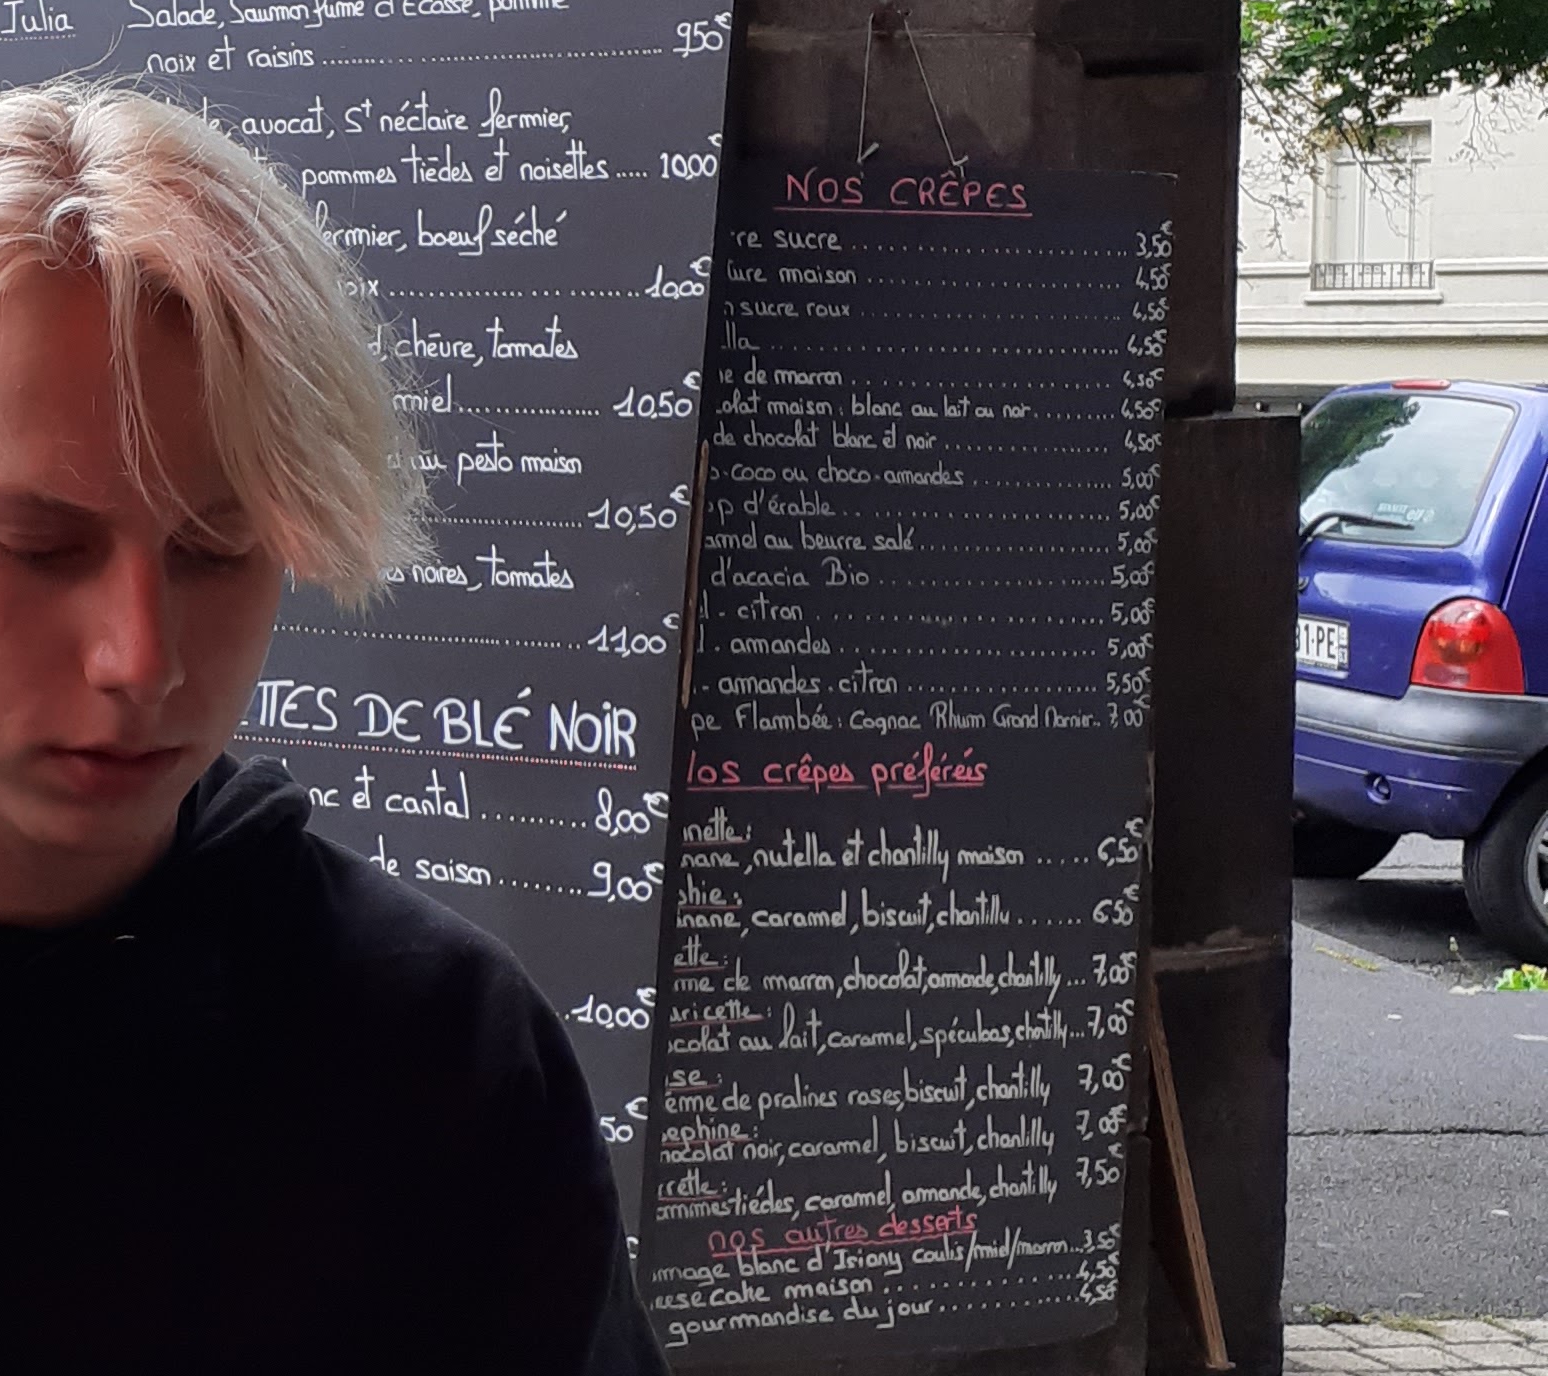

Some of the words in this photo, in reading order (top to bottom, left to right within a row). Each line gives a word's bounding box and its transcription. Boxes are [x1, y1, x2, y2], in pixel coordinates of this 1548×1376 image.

[146, 49, 196, 76] noix
[208, 35, 237, 72] et
[247, 42, 316, 69] raisins
[302, 165, 398, 200] pommes
[485, 137, 510, 181] et
[520, 138, 610, 182] noisettes
[786, 166, 864, 205] NOS
[889, 172, 1029, 211] CRÊPES
[417, 204, 493, 256] boeuf
[490, 204, 568, 248] séché
[774, 229, 843, 251] sucre
[778, 265, 857, 285] maison
[741, 301, 799, 318] sucre
[806, 303, 851, 318] roux
[485, 314, 580, 360] tomates
[743, 354, 769, 385] de
[774, 369, 844, 387] marron
[851, 390, 903, 417] blanc
[910, 404, 939, 418] au
[943, 394, 971, 418] lait
[713, 420, 737, 446] de
[743, 418, 821, 448] chocolat
[832, 420, 878, 449] blanc
[457, 429, 513, 487] pesto
[521, 447, 583, 474] maison
[763, 533, 794, 551] au
[800, 520, 867, 551] beurre
[475, 543, 575, 589] tomates
[821, 555, 870, 587] Bio
[737, 591, 804, 621] citron
[729, 625, 832, 655] amandes
[717, 664, 822, 695] amandes
[838, 659, 898, 694] citron
[354, 693, 425, 744] DE
[433, 685, 532, 751] BLÉ
[929, 698, 986, 730] Rhum
[762, 752, 855, 795] crêpes
[352, 764, 375, 810] et
[384, 768, 471, 821] cantal
[842, 827, 865, 867] et
[867, 824, 950, 885] chantilly
[956, 844, 1025, 866] maison
[414, 858, 492, 887] saison
[738, 1035, 773, 1052] au
[721, 1080, 752, 1112] de
[757, 1073, 838, 1121] pralines
[708, 1228, 766, 1252] nos
[784, 1214, 869, 1245] autres
[877, 1204, 978, 1239] desserts
[736, 1243, 801, 1277] blanc
[784, 1277, 874, 1300] maison
[664, 1301, 835, 1349] gourmandise
[843, 1295, 880, 1321] du
[876, 1298, 934, 1330] jour
